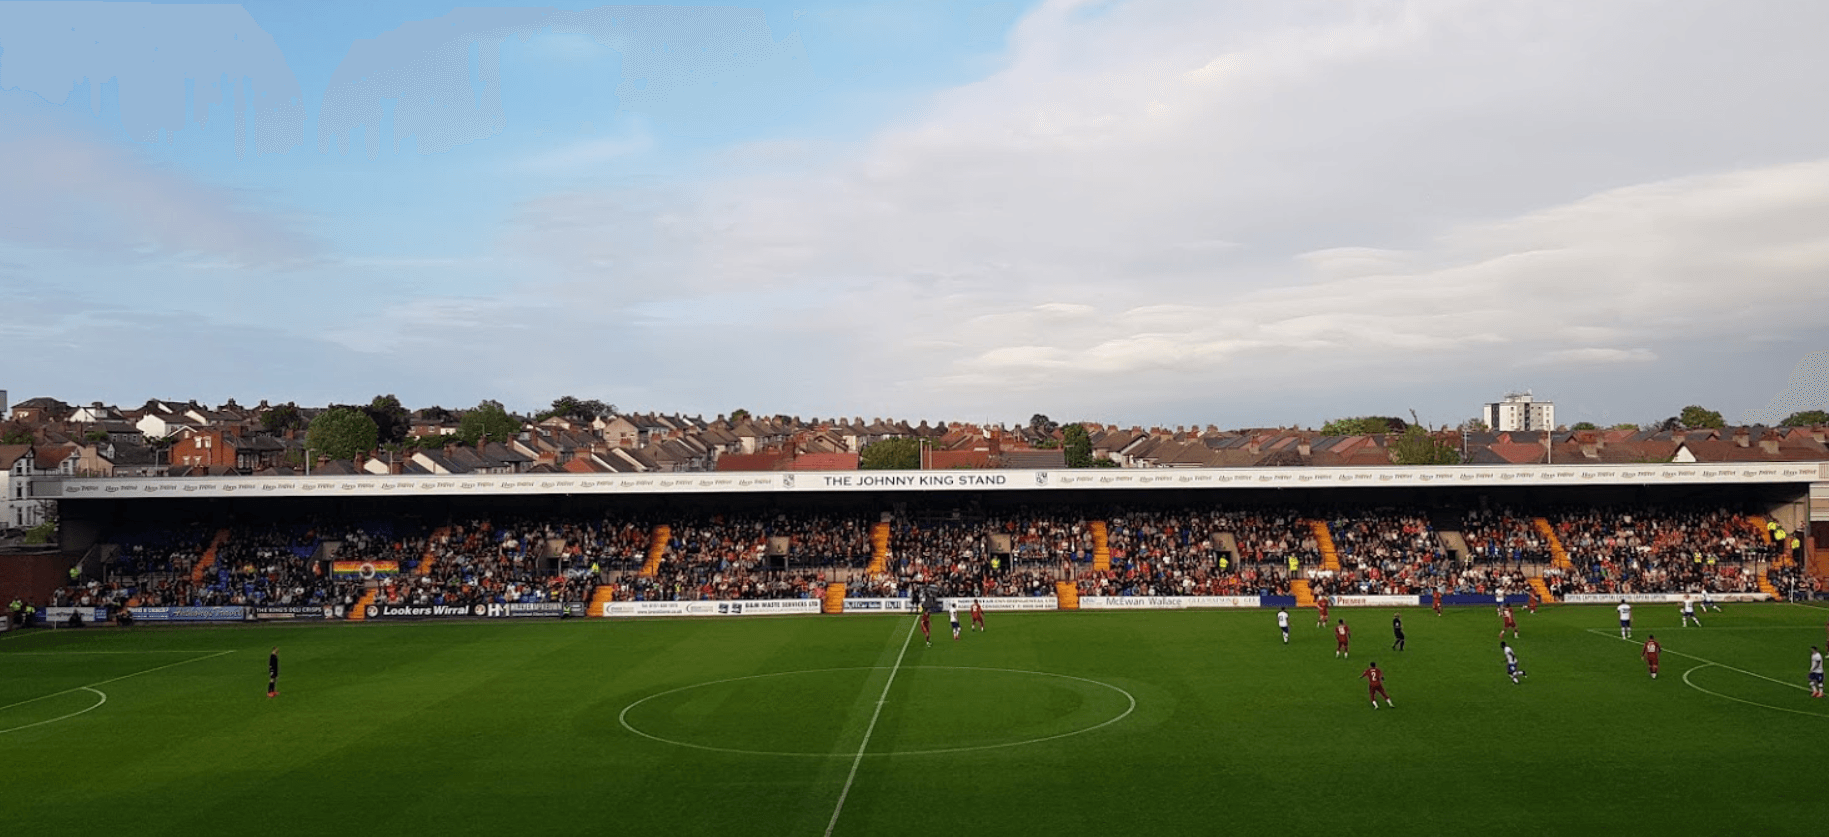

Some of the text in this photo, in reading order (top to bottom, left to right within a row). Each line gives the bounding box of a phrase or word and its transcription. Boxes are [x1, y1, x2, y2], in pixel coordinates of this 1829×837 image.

[824, 475, 1006, 486] THE JOHNNY KING STAND
[1106, 598, 1144, 606] McEwan
[1148, 597, 1182, 606] Wallace
[383, 606, 469, 615] Lookers Wirral
[1371, 672, 1377, 682] 2
